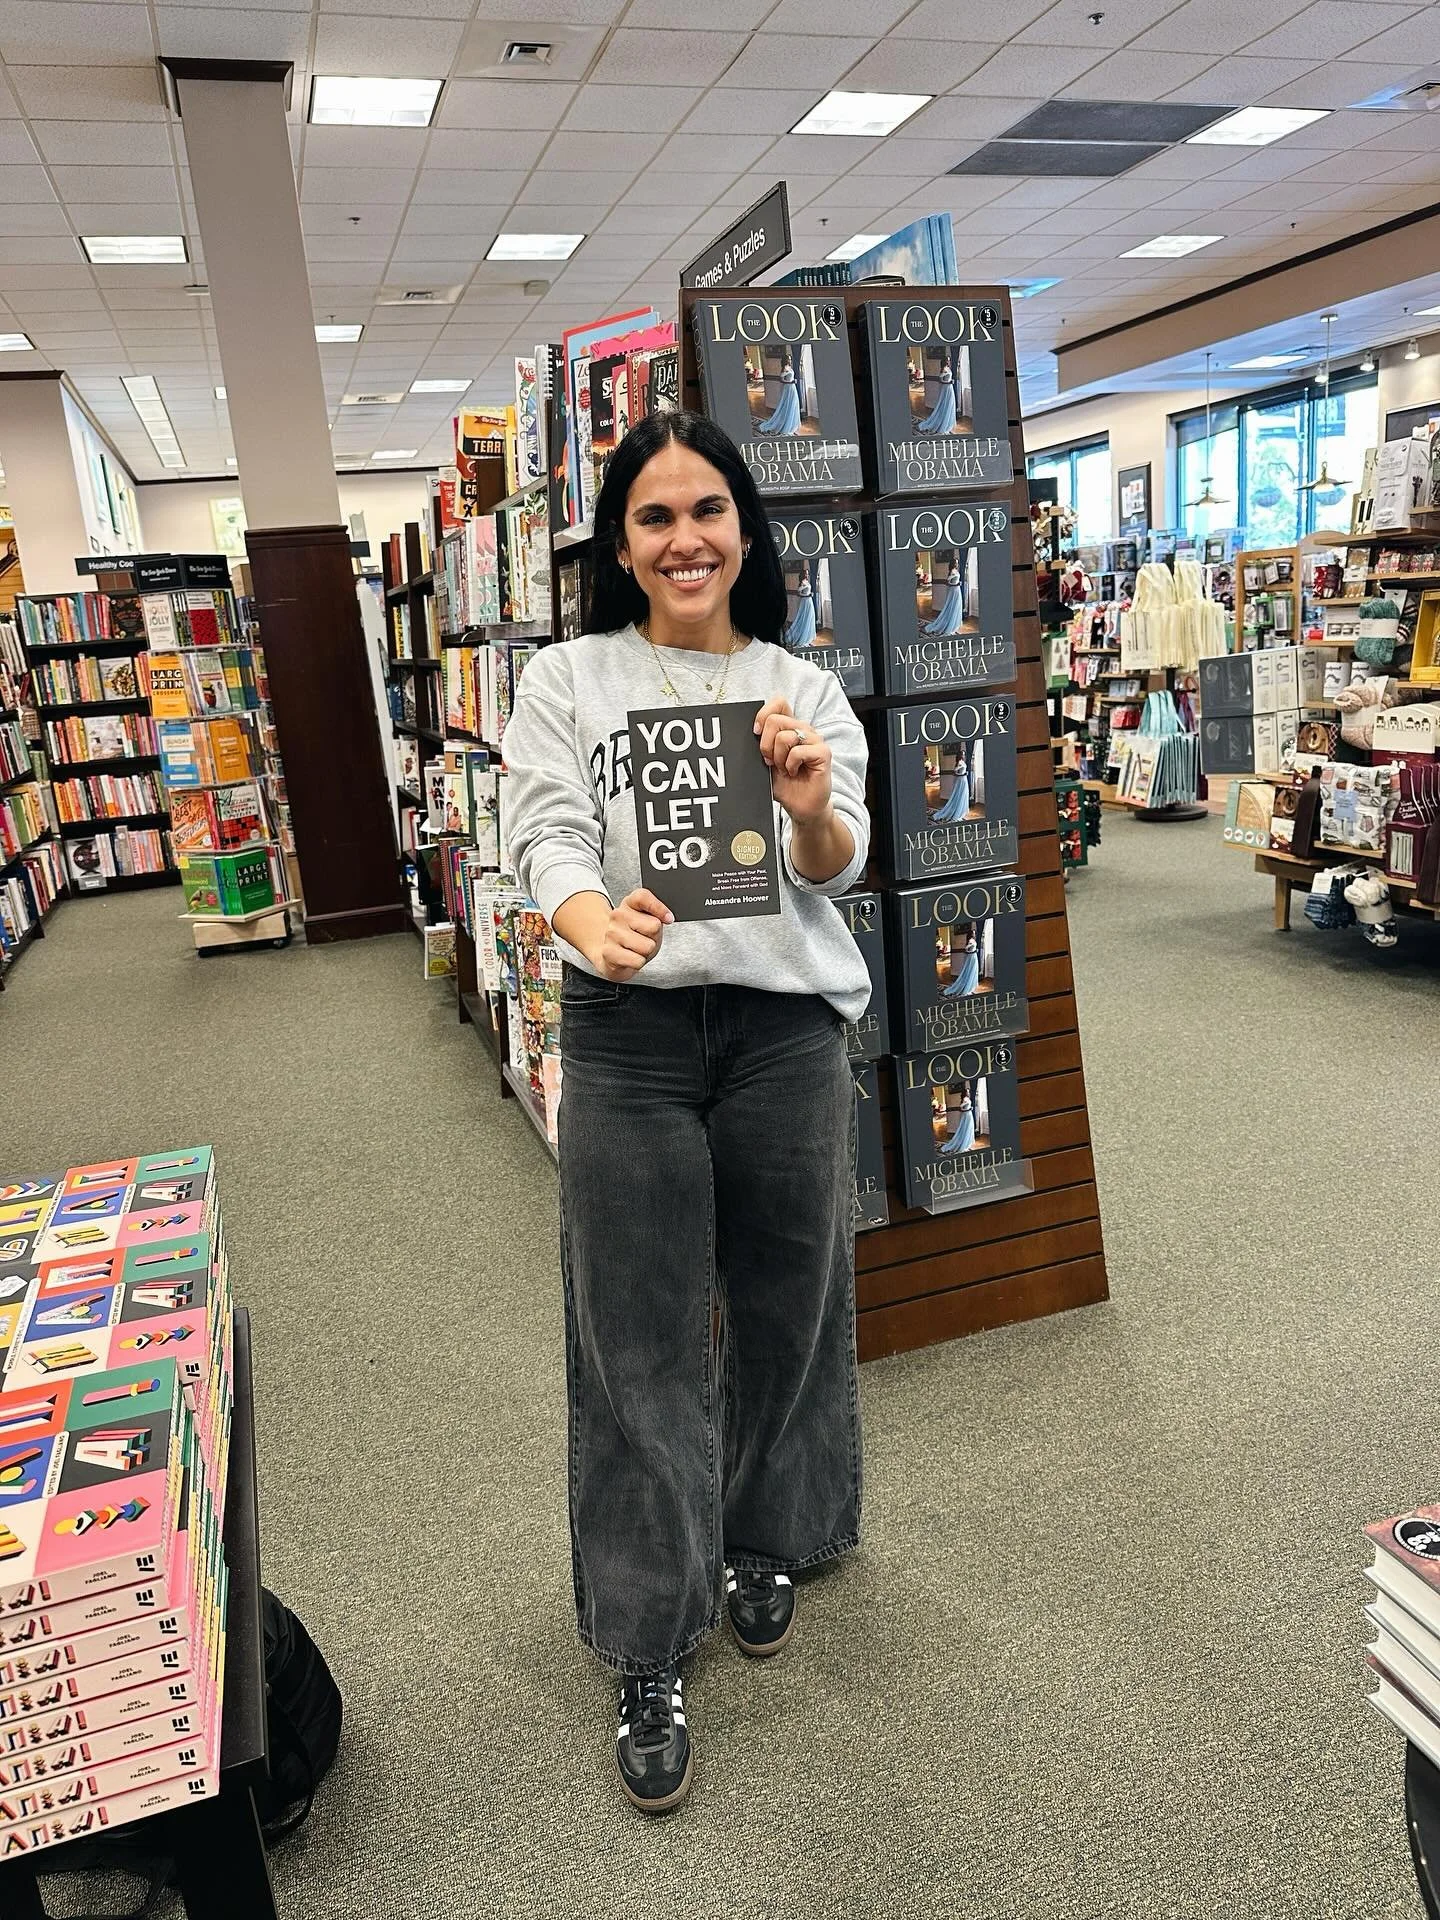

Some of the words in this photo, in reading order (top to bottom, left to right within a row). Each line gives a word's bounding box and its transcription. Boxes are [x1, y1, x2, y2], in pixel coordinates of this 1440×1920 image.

[695, 262, 723, 288] Games
[724, 251, 732, 275] &
[733, 227, 765, 268] Puzzles
[708, 303, 840, 342] LOOK
[876, 305, 996, 343] LOOK
[887, 438, 1000, 463] MICHELLE
[749, 461, 834, 485] OBAMA
[906, 459, 985, 482] OBAMA
[767, 518, 856, 557] OOK
[886, 508, 1004, 551] LOOK
[88, 561, 117, 570] Healthy
[895, 635, 1006, 666] MICHELLE
[151, 670, 182, 679] LARG
[912, 659, 990, 683] OBAMA
[636, 717, 722, 754] YOU
[897, 703, 1009, 746] LOOK
[641, 756, 726, 794] CAN
[645, 796, 719, 833] LET
[736, 844, 760, 854] SIGNED
[904, 818, 1010, 852] MICHELLE
[237, 862, 268, 877] LARGE
[648, 836, 711, 871] GO
[920, 840, 995, 866] OBAMA
[704, 896, 742, 906] Alexandra
[742, 895, 769, 903] Hoover
[911, 883, 1019, 929] LOOK
[478, 903, 491, 937] UNIVERSE
[541, 949, 560, 962] FUCK
[915, 991, 1018, 1026] MICHELLE
[931, 1010, 1003, 1039] OBAMA
[906, 1043, 1010, 1089] LOOK
[914, 1147, 1014, 1183] MICHELLE
[930, 1165, 1001, 1195] OBAMA
[137, 1765, 151, 1773] JOEL
